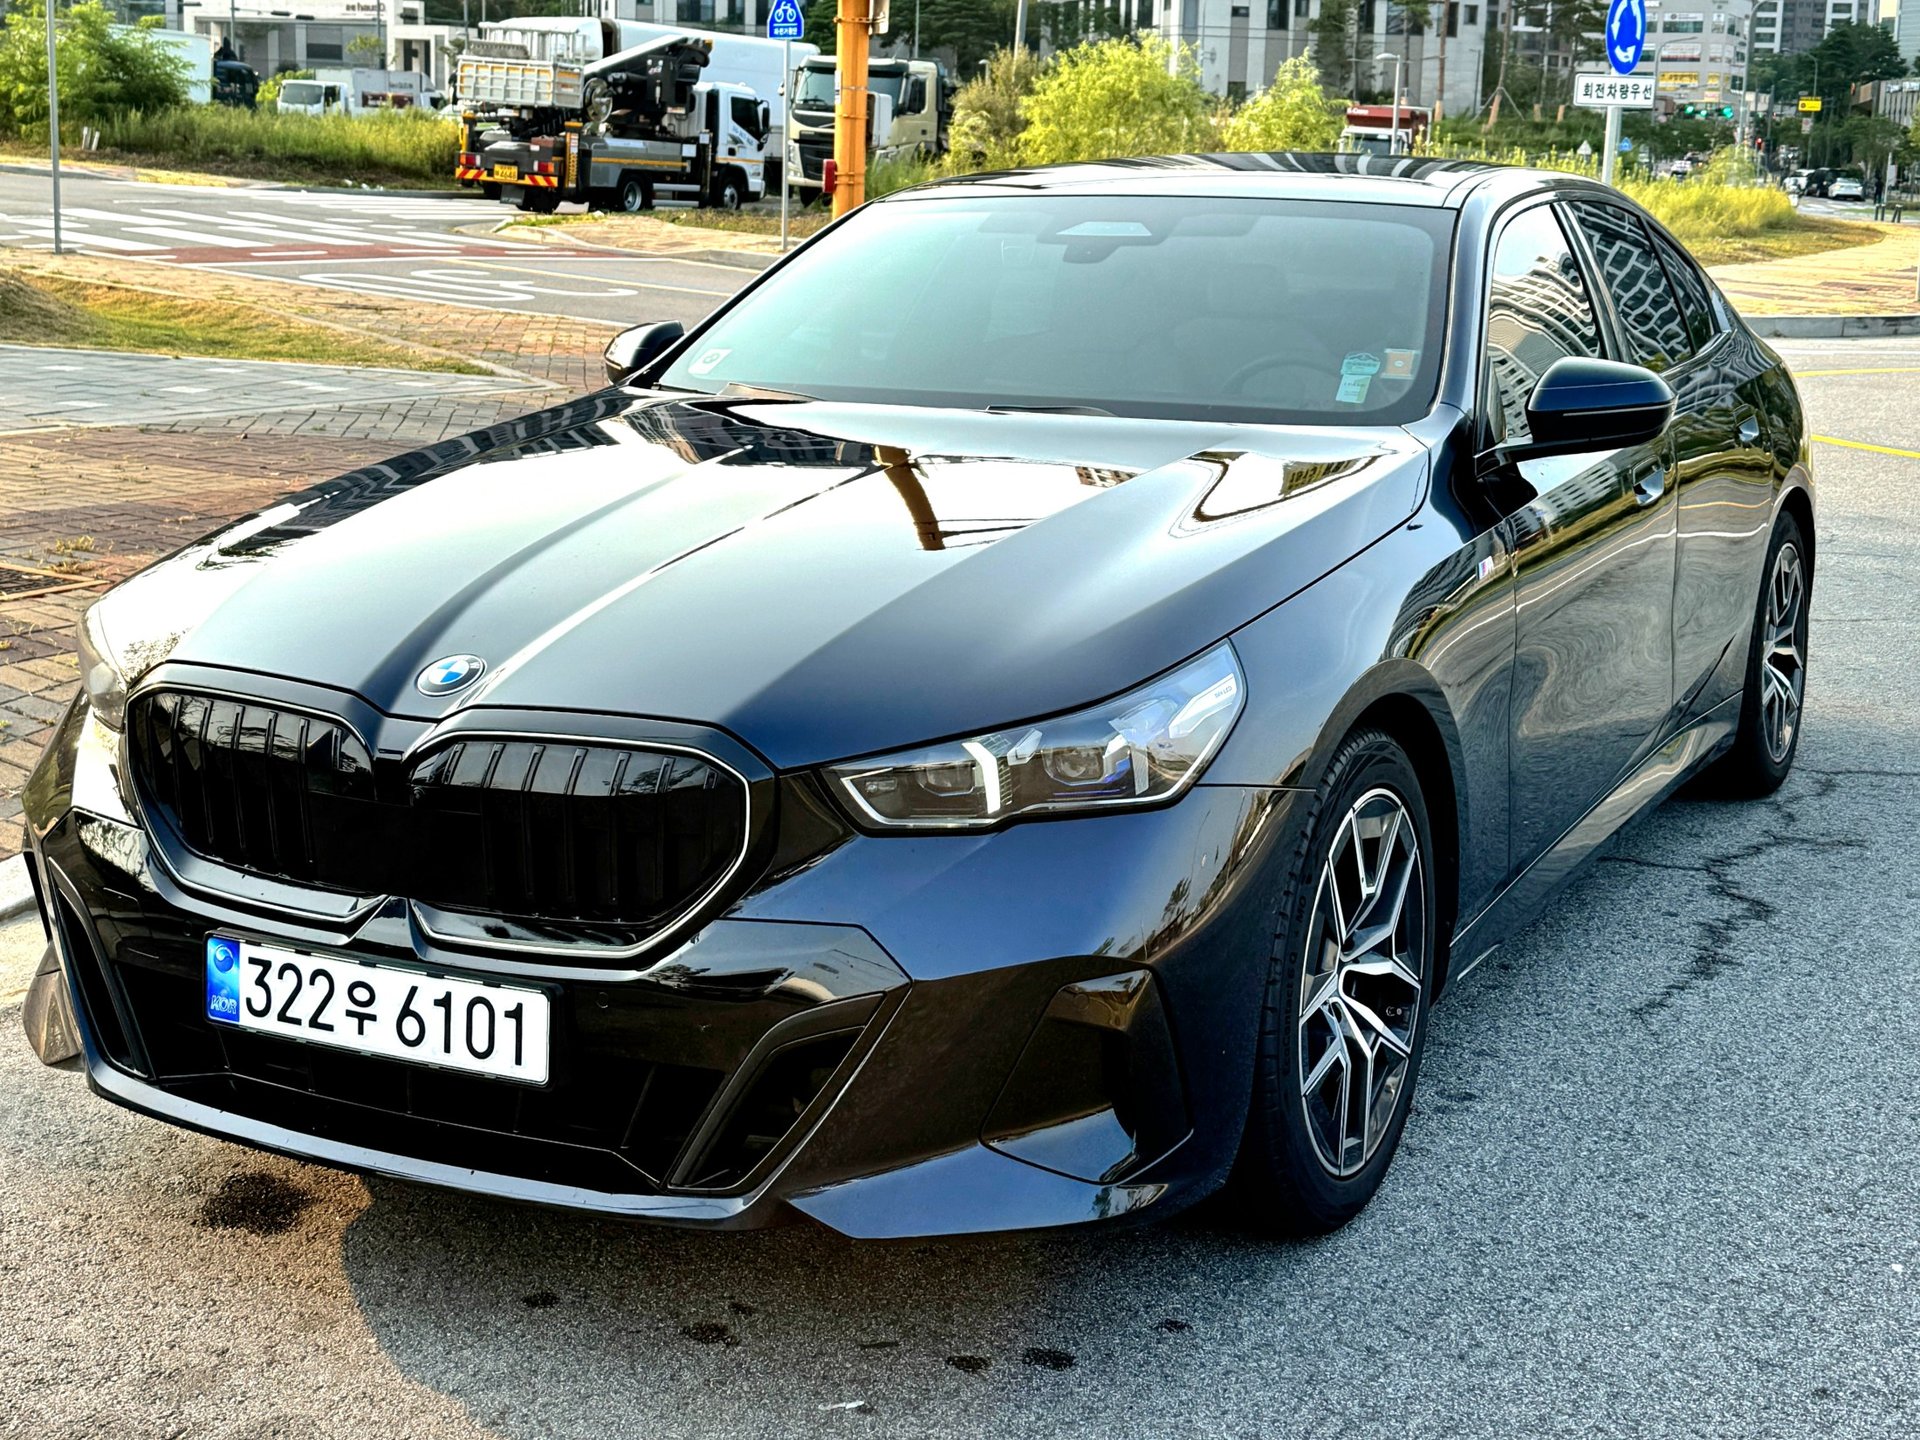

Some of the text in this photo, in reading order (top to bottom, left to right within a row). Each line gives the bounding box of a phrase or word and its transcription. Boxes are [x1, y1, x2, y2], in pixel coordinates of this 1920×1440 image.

[1582, 82, 1652, 100] 회전차량우선
[210, 995, 237, 1015] KOR
[245, 956, 524, 1066] 322우 6101
[1281, 982, 1294, 1076] EcoContact
